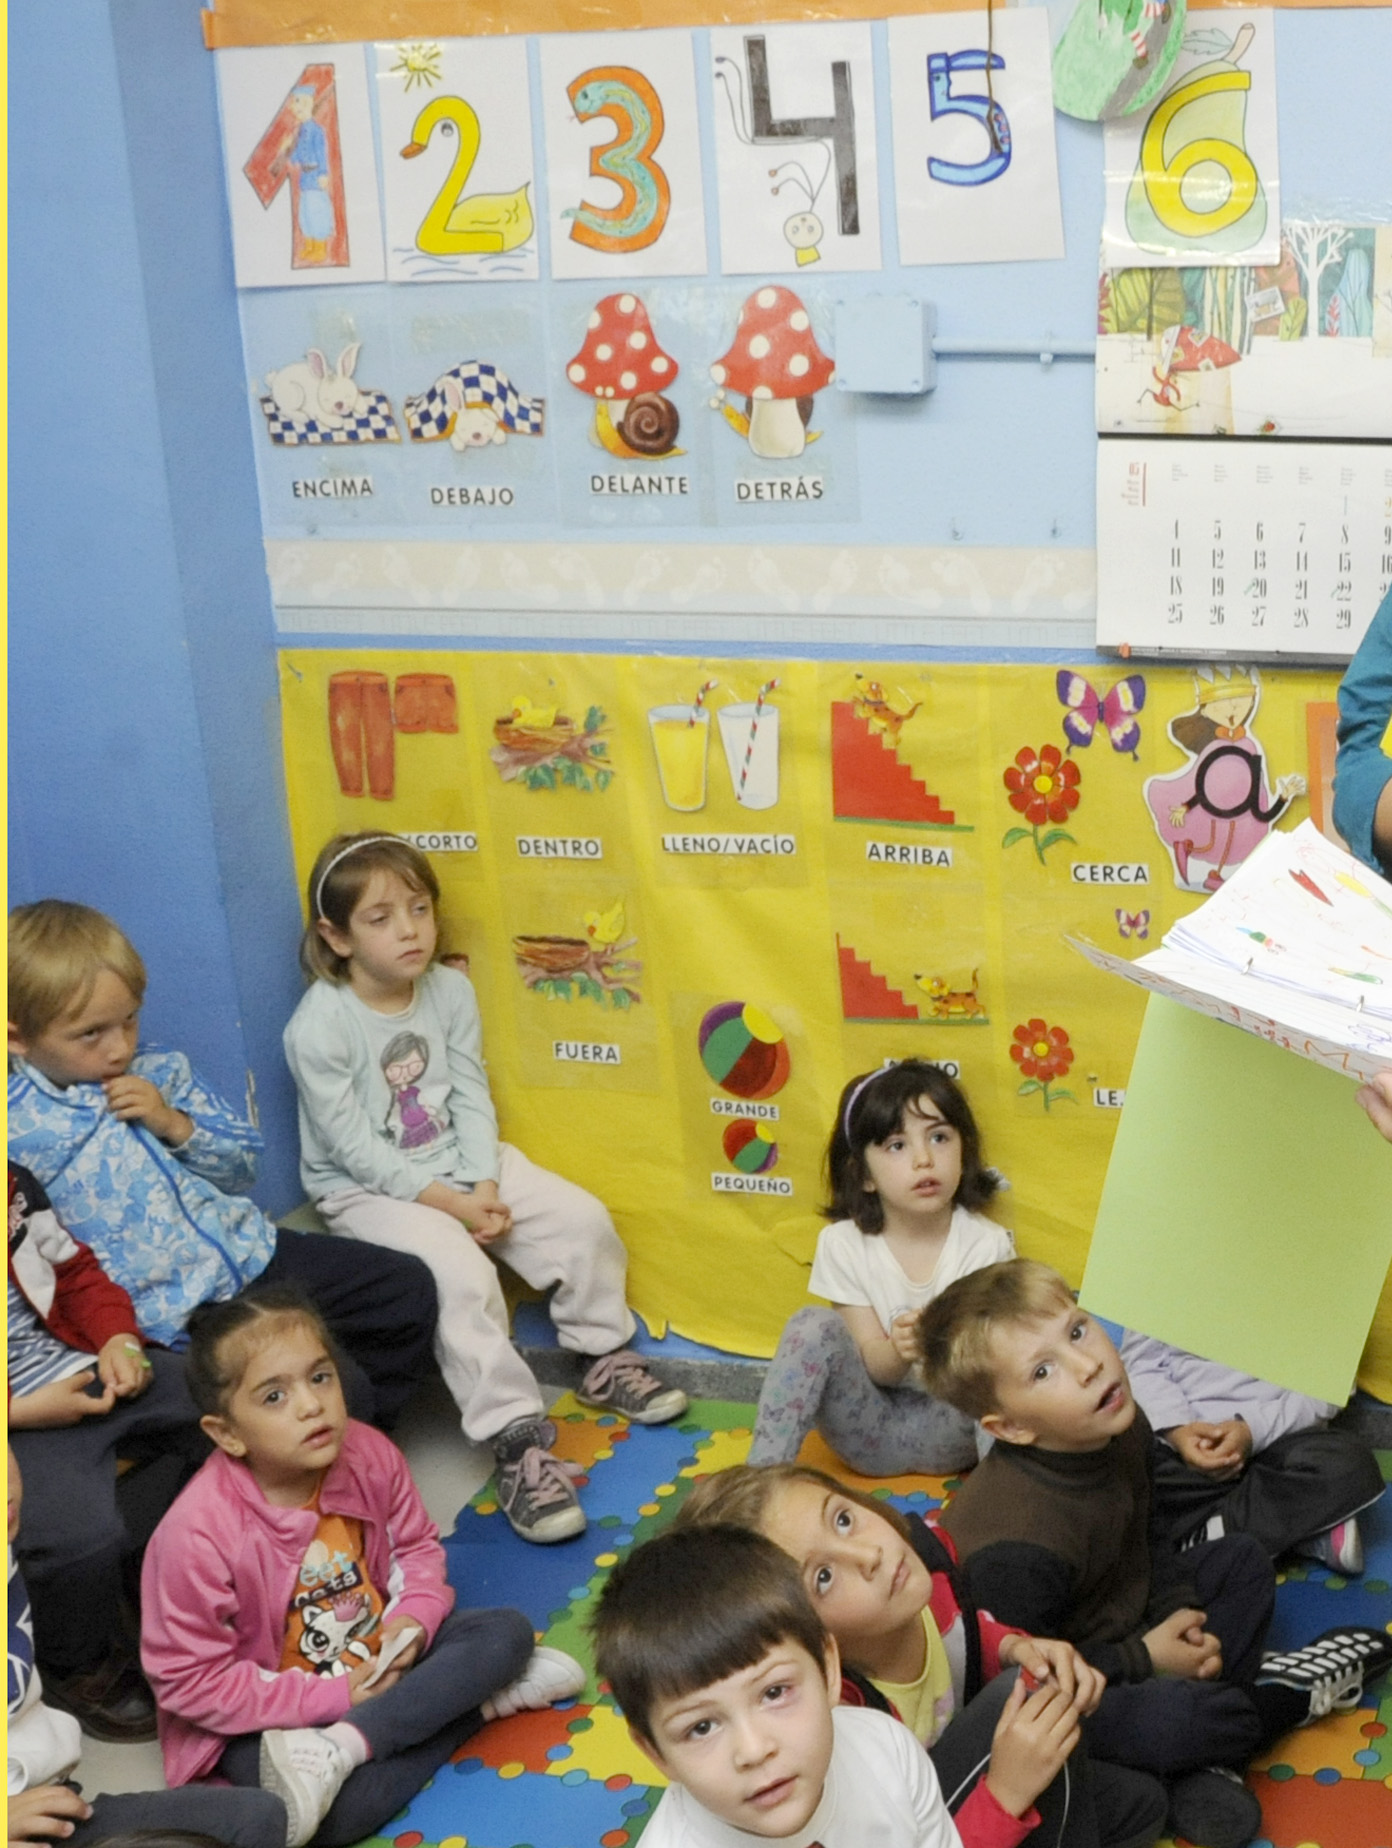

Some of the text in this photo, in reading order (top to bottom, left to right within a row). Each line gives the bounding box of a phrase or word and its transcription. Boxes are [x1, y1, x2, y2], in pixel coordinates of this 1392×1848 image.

[243, 34, 1259, 270] 1 2 3 4 5 6
[292, 477, 374, 499] ENCIMA
[590, 474, 690, 496] DELANTE
[735, 476, 824, 502] DETRÁS
[430, 486, 515, 507] DEBAJO
[1255, 521, 1264, 542] 6
[1298, 522, 1307, 543] 7
[1384, 525, 1392, 546] 9
[1170, 546, 1181, 568] 11
[1212, 548, 1225, 570] 12
[1253, 549, 1267, 570] 13
[1338, 552, 1352, 573] 15
[1212, 576, 1225, 597] 19
[1251, 577, 1268, 599] 20
[1294, 579, 1308, 600] 21
[1336, 580, 1352, 602] 22
[1167, 603, 1352, 630] 25 26 27 28 29
[517, 836, 601, 857] DENTRO
[867, 843, 951, 867] ARRIBA
[1072, 864, 1149, 884] CERCA
[554, 1042, 619, 1063] FUERA
[711, 1101, 779, 1120] GRANDE
[713, 1175, 791, 1195] PEQUEÑO
